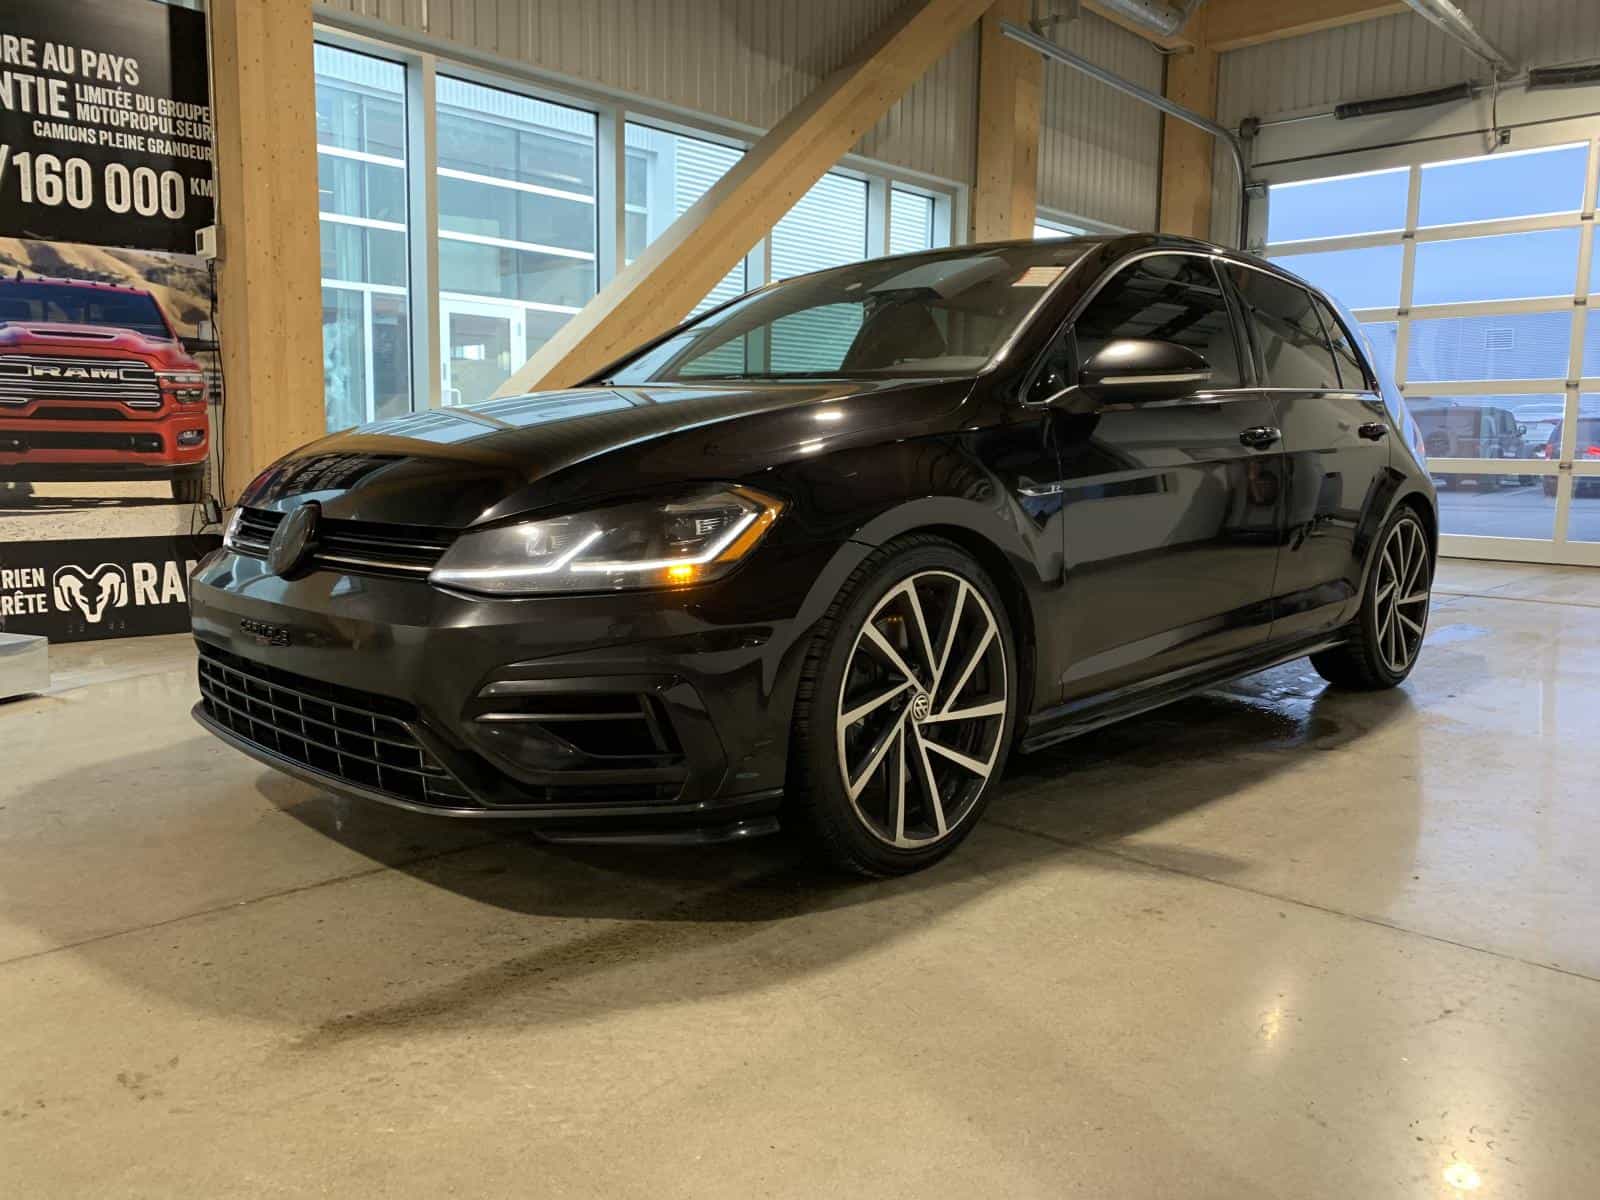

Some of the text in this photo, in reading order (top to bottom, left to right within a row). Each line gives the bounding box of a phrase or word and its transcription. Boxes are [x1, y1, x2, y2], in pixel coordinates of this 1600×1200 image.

[0, 34, 140, 87] RE AU PAYS
[75, 83, 211, 124] LIMITÉE DU GROUPE
[76, 103, 213, 141] MOTOPROPULSEUR
[33, 120, 214, 161] CAMIONS PLEINE GRANDEUR
[104, 162, 186, 220] 000
[190, 177, 214, 197] KM
[33, 365, 120, 379] RAM
[1, 568, 45, 589] RIEN
[0, 590, 48, 616] RÊTE
